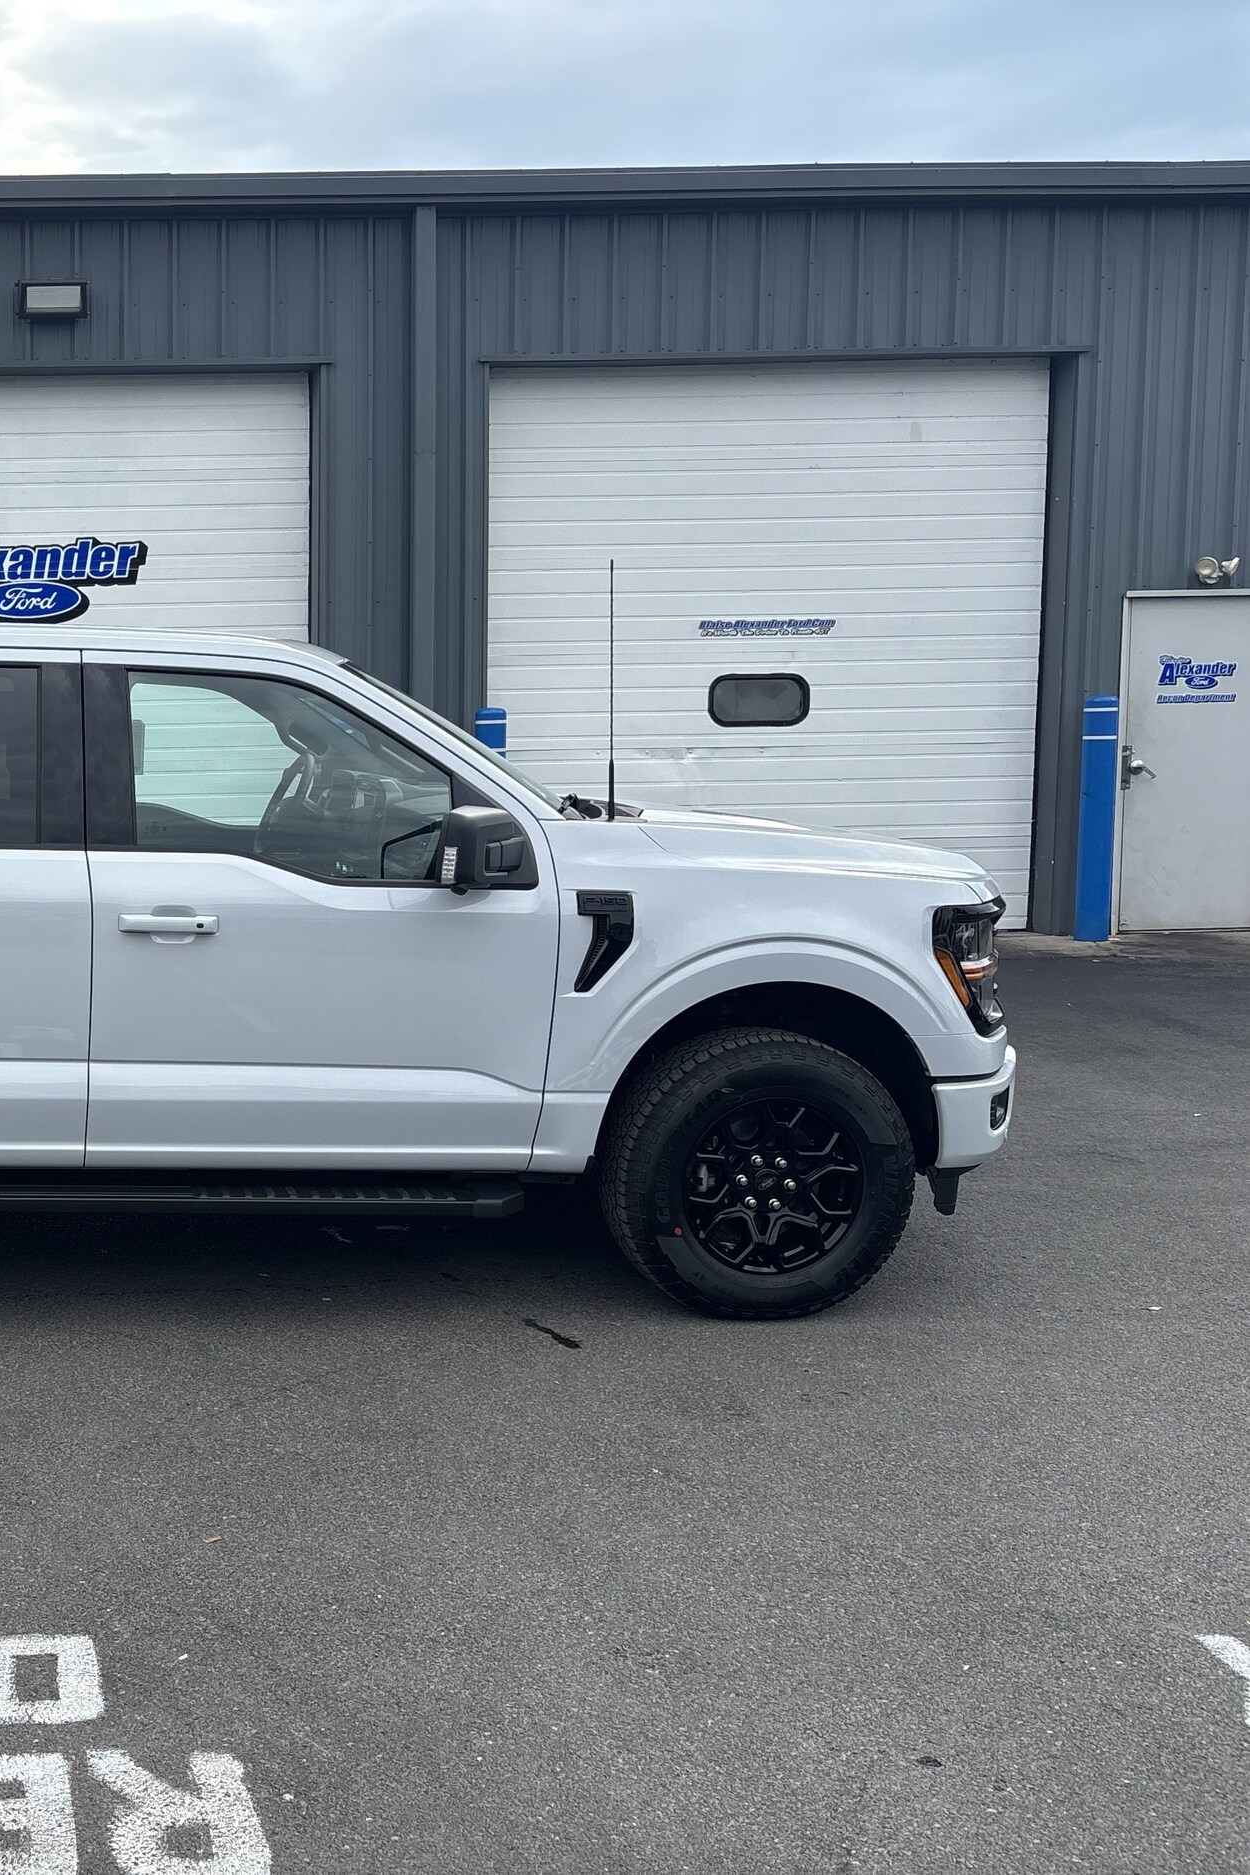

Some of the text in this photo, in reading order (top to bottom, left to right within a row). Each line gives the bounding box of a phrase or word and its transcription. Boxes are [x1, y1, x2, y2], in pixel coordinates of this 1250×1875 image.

[0, 587, 58, 611] Ford
[1158, 661, 1236, 685] Alexander
[1190, 677, 1209, 686] Ford
